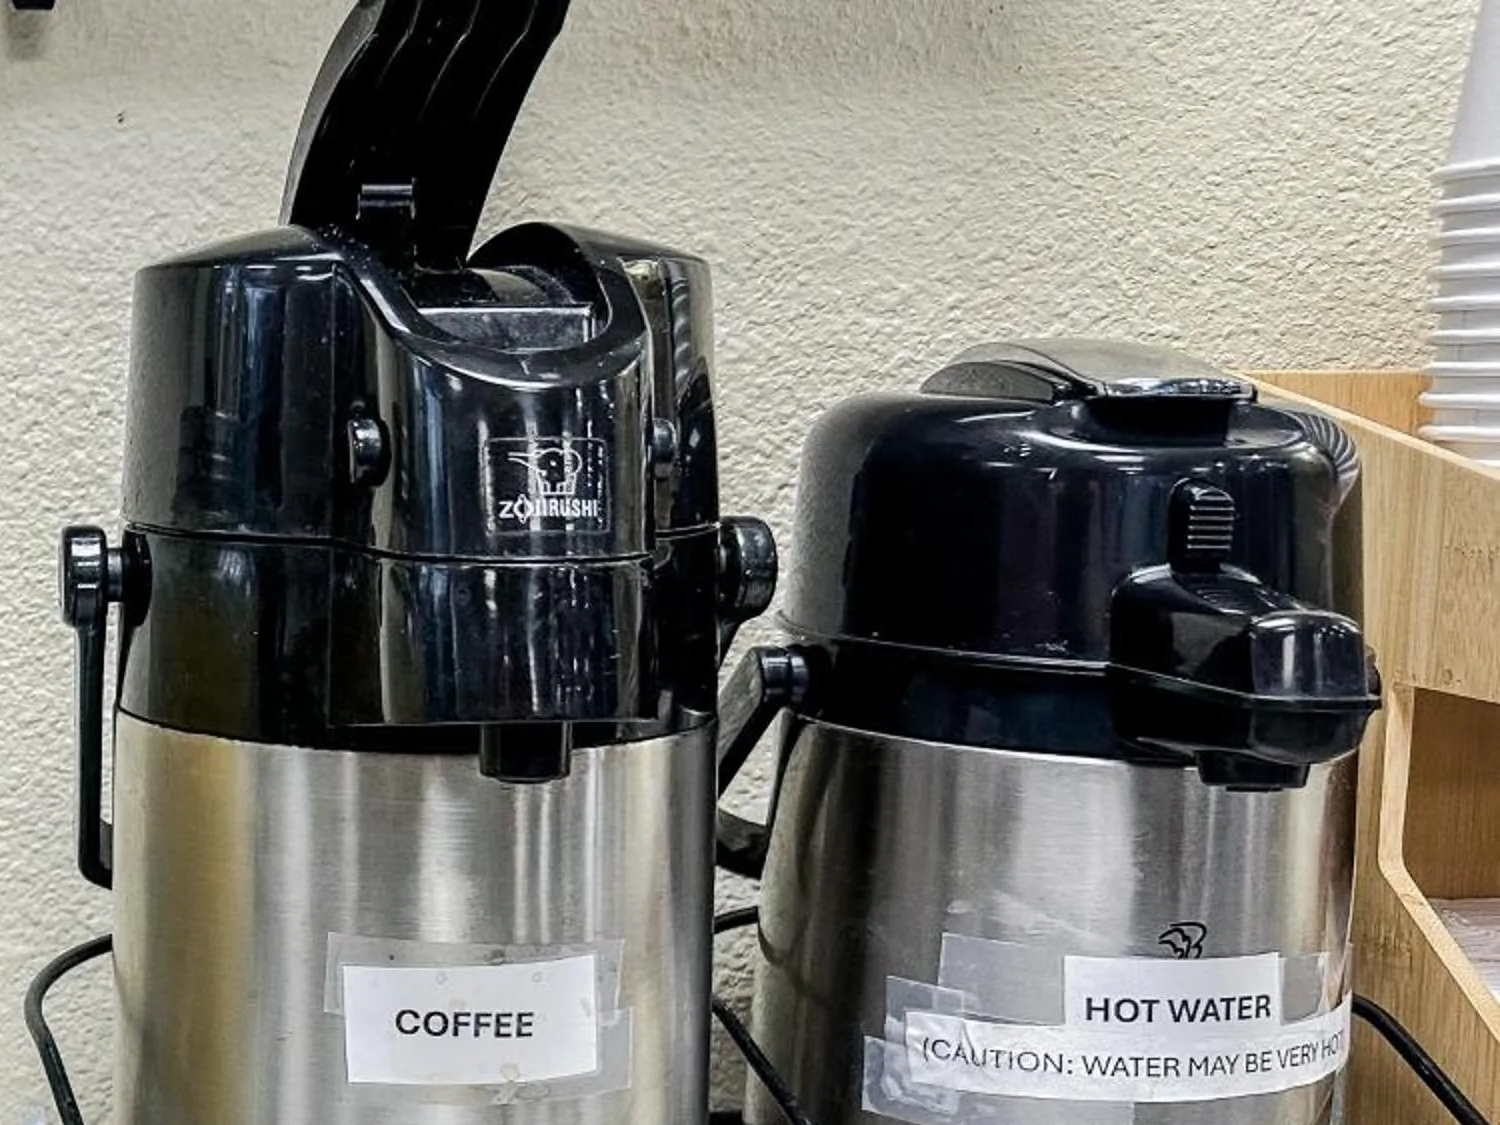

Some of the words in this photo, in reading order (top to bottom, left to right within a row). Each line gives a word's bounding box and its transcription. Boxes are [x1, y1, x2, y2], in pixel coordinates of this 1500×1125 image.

[1085, 996, 1161, 1023] HOT
[1168, 994, 1272, 1023] WATER
[395, 1009, 534, 1038] COFFEE
[922, 1038, 1074, 1075] (CAUTION:
[1081, 1055, 1180, 1077] WATER
[1188, 1054, 1240, 1077] MAY
[1245, 1050, 1273, 1073] BE
[1277, 1041, 1319, 1069] VERY
